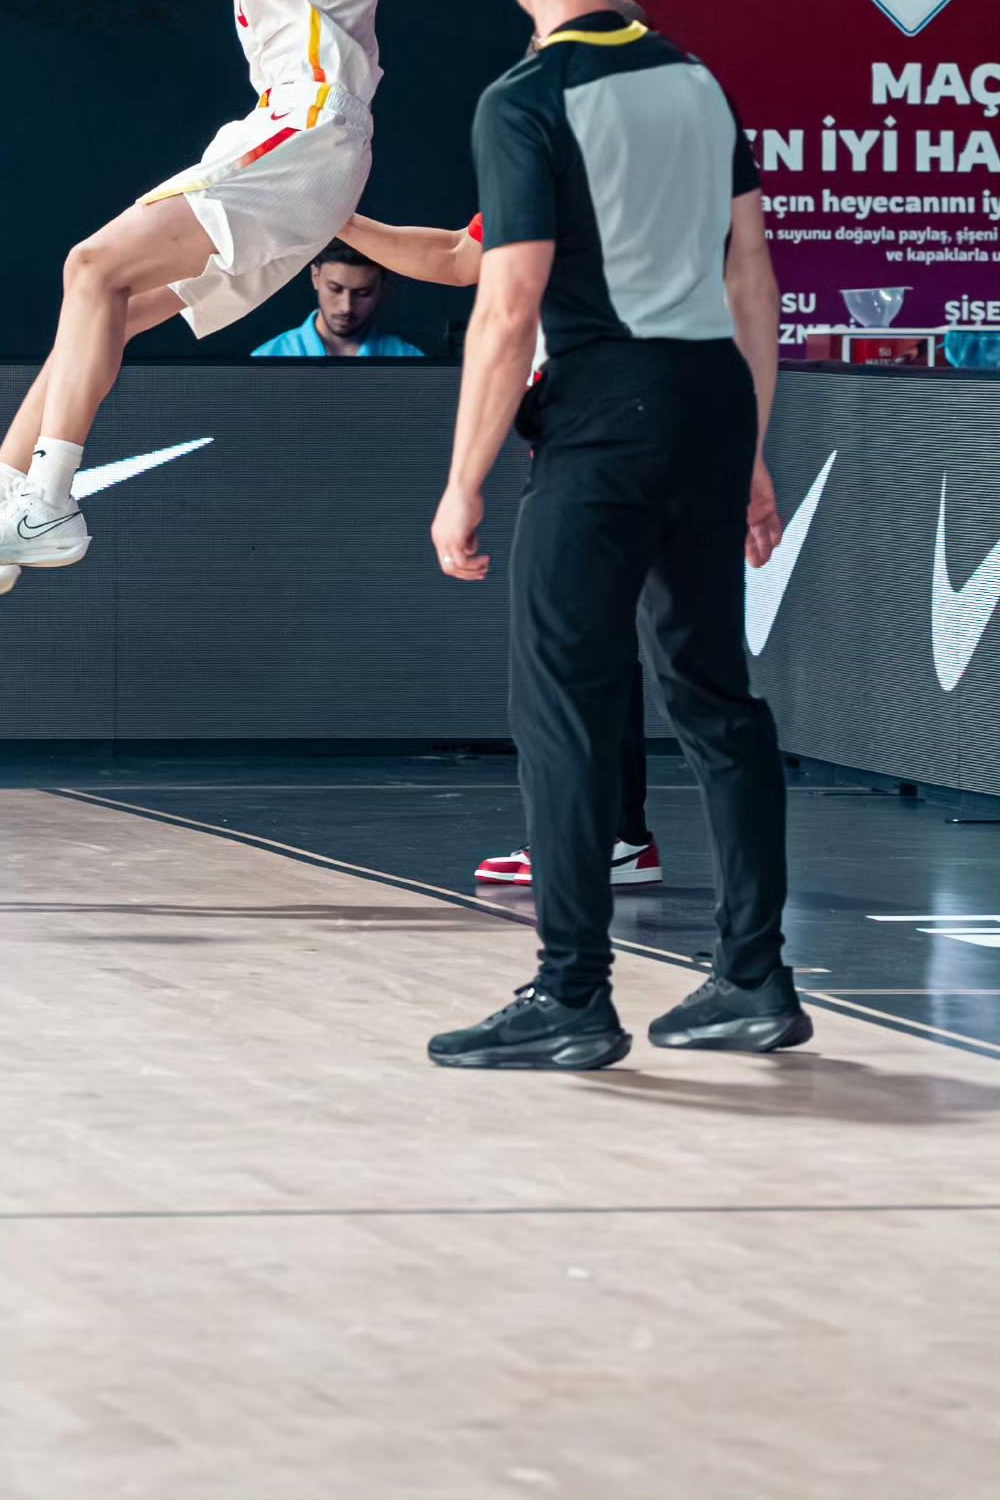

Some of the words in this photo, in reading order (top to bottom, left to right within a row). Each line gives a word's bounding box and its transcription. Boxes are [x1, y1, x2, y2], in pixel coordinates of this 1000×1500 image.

[822, 115, 898, 172] İYİ
[822, 189, 975, 220] heyecanını
[777, 229, 832, 244] suyunu
[835, 226, 896, 244] doğayla
[956, 227, 998, 244] şişeni
[886, 251, 903, 262] ve
[907, 248, 989, 265] kapaklarla
[781, 293, 816, 314] SU
